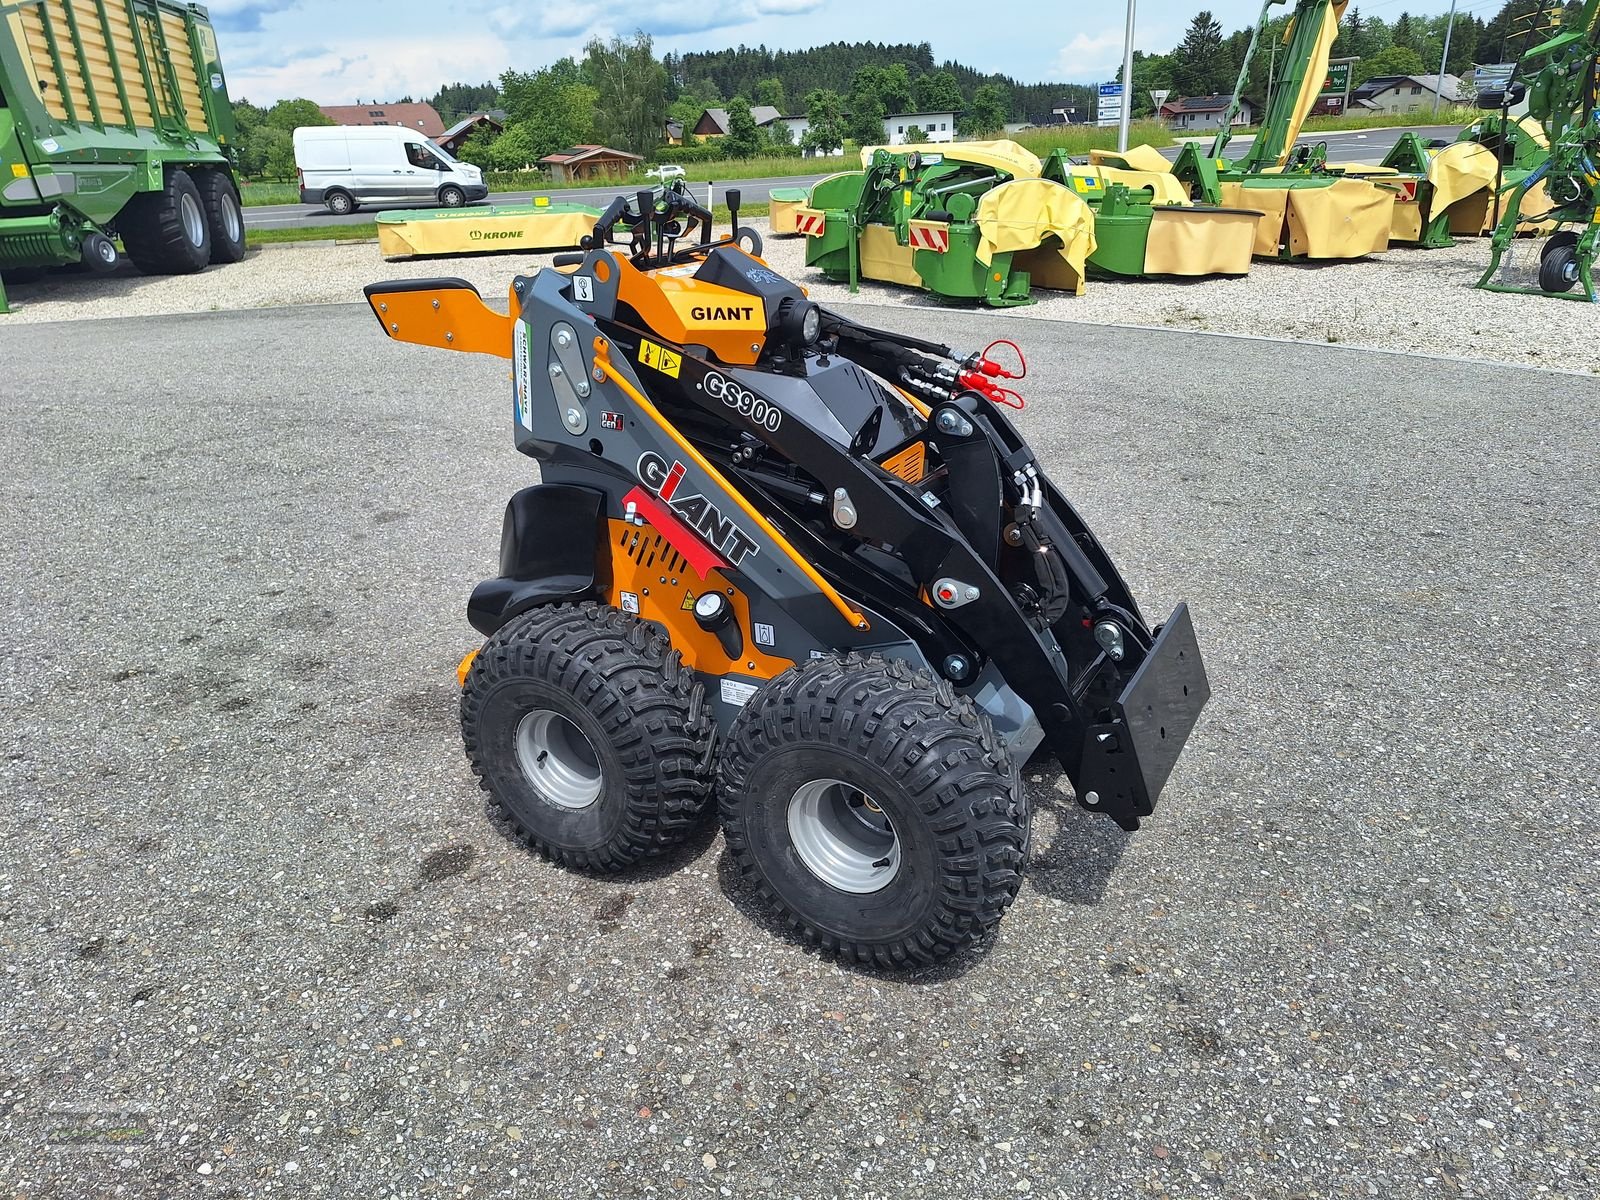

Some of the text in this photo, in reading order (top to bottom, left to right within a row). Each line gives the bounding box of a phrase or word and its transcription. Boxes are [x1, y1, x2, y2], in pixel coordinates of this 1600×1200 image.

[483, 230, 524, 240] KRONE
[691, 306, 753, 321] GIANT
[703, 371, 782, 432] GS900
